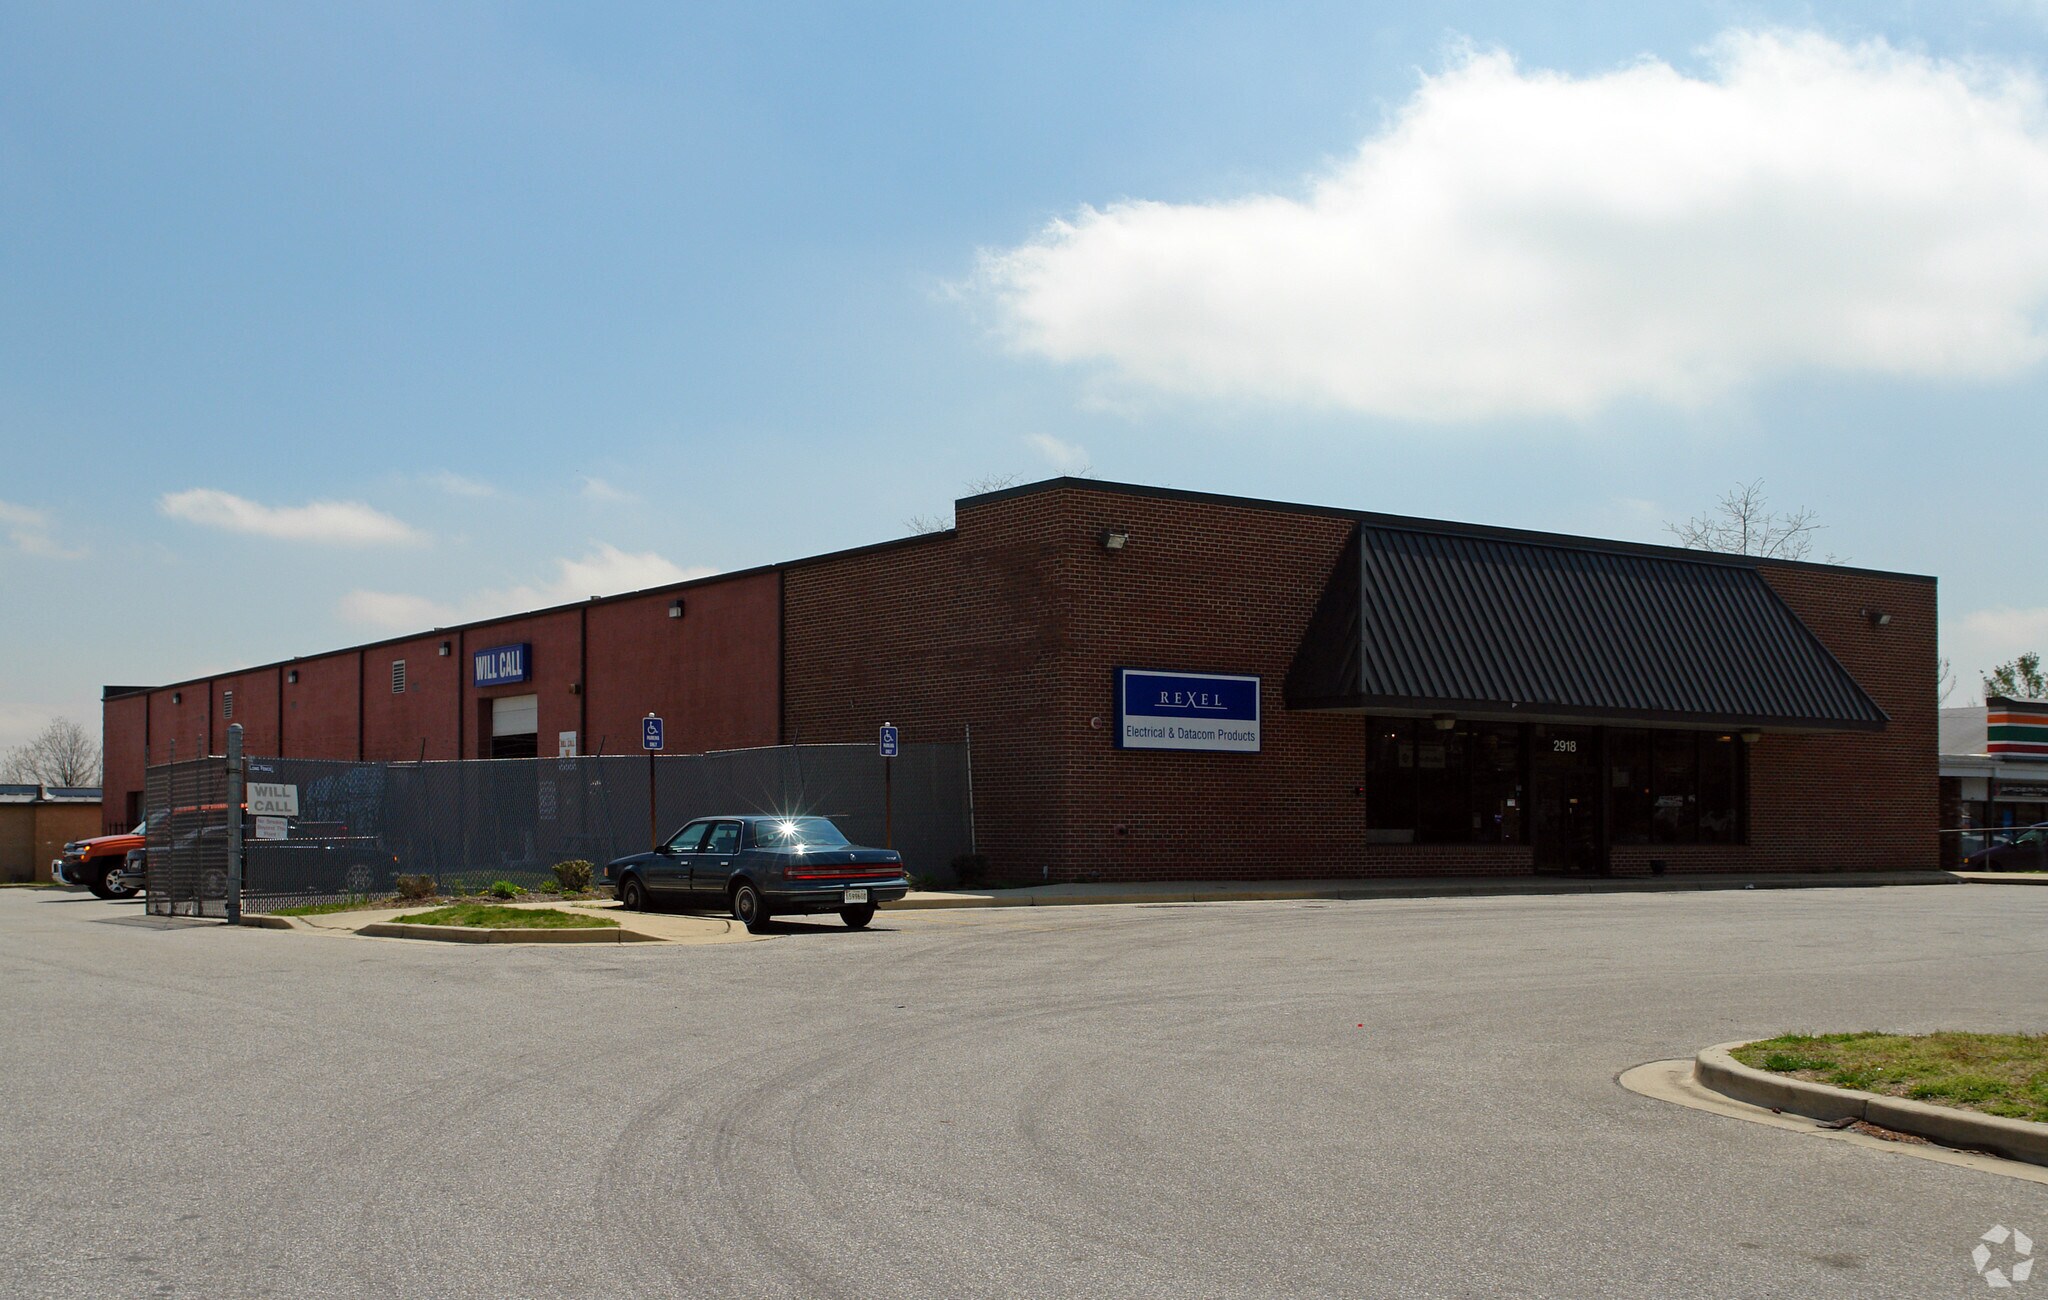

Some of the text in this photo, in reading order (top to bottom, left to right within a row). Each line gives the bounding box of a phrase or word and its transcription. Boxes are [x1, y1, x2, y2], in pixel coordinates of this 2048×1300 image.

[475, 650, 522, 681] WILL CALL
[1160, 691, 1222, 708] REXEL
[1126, 725, 1256, 742] Electrical & Datacom Products
[1554, 740, 1576, 752] 2918
[254, 785, 291, 798] WILL
[254, 800, 292, 812] CALL
